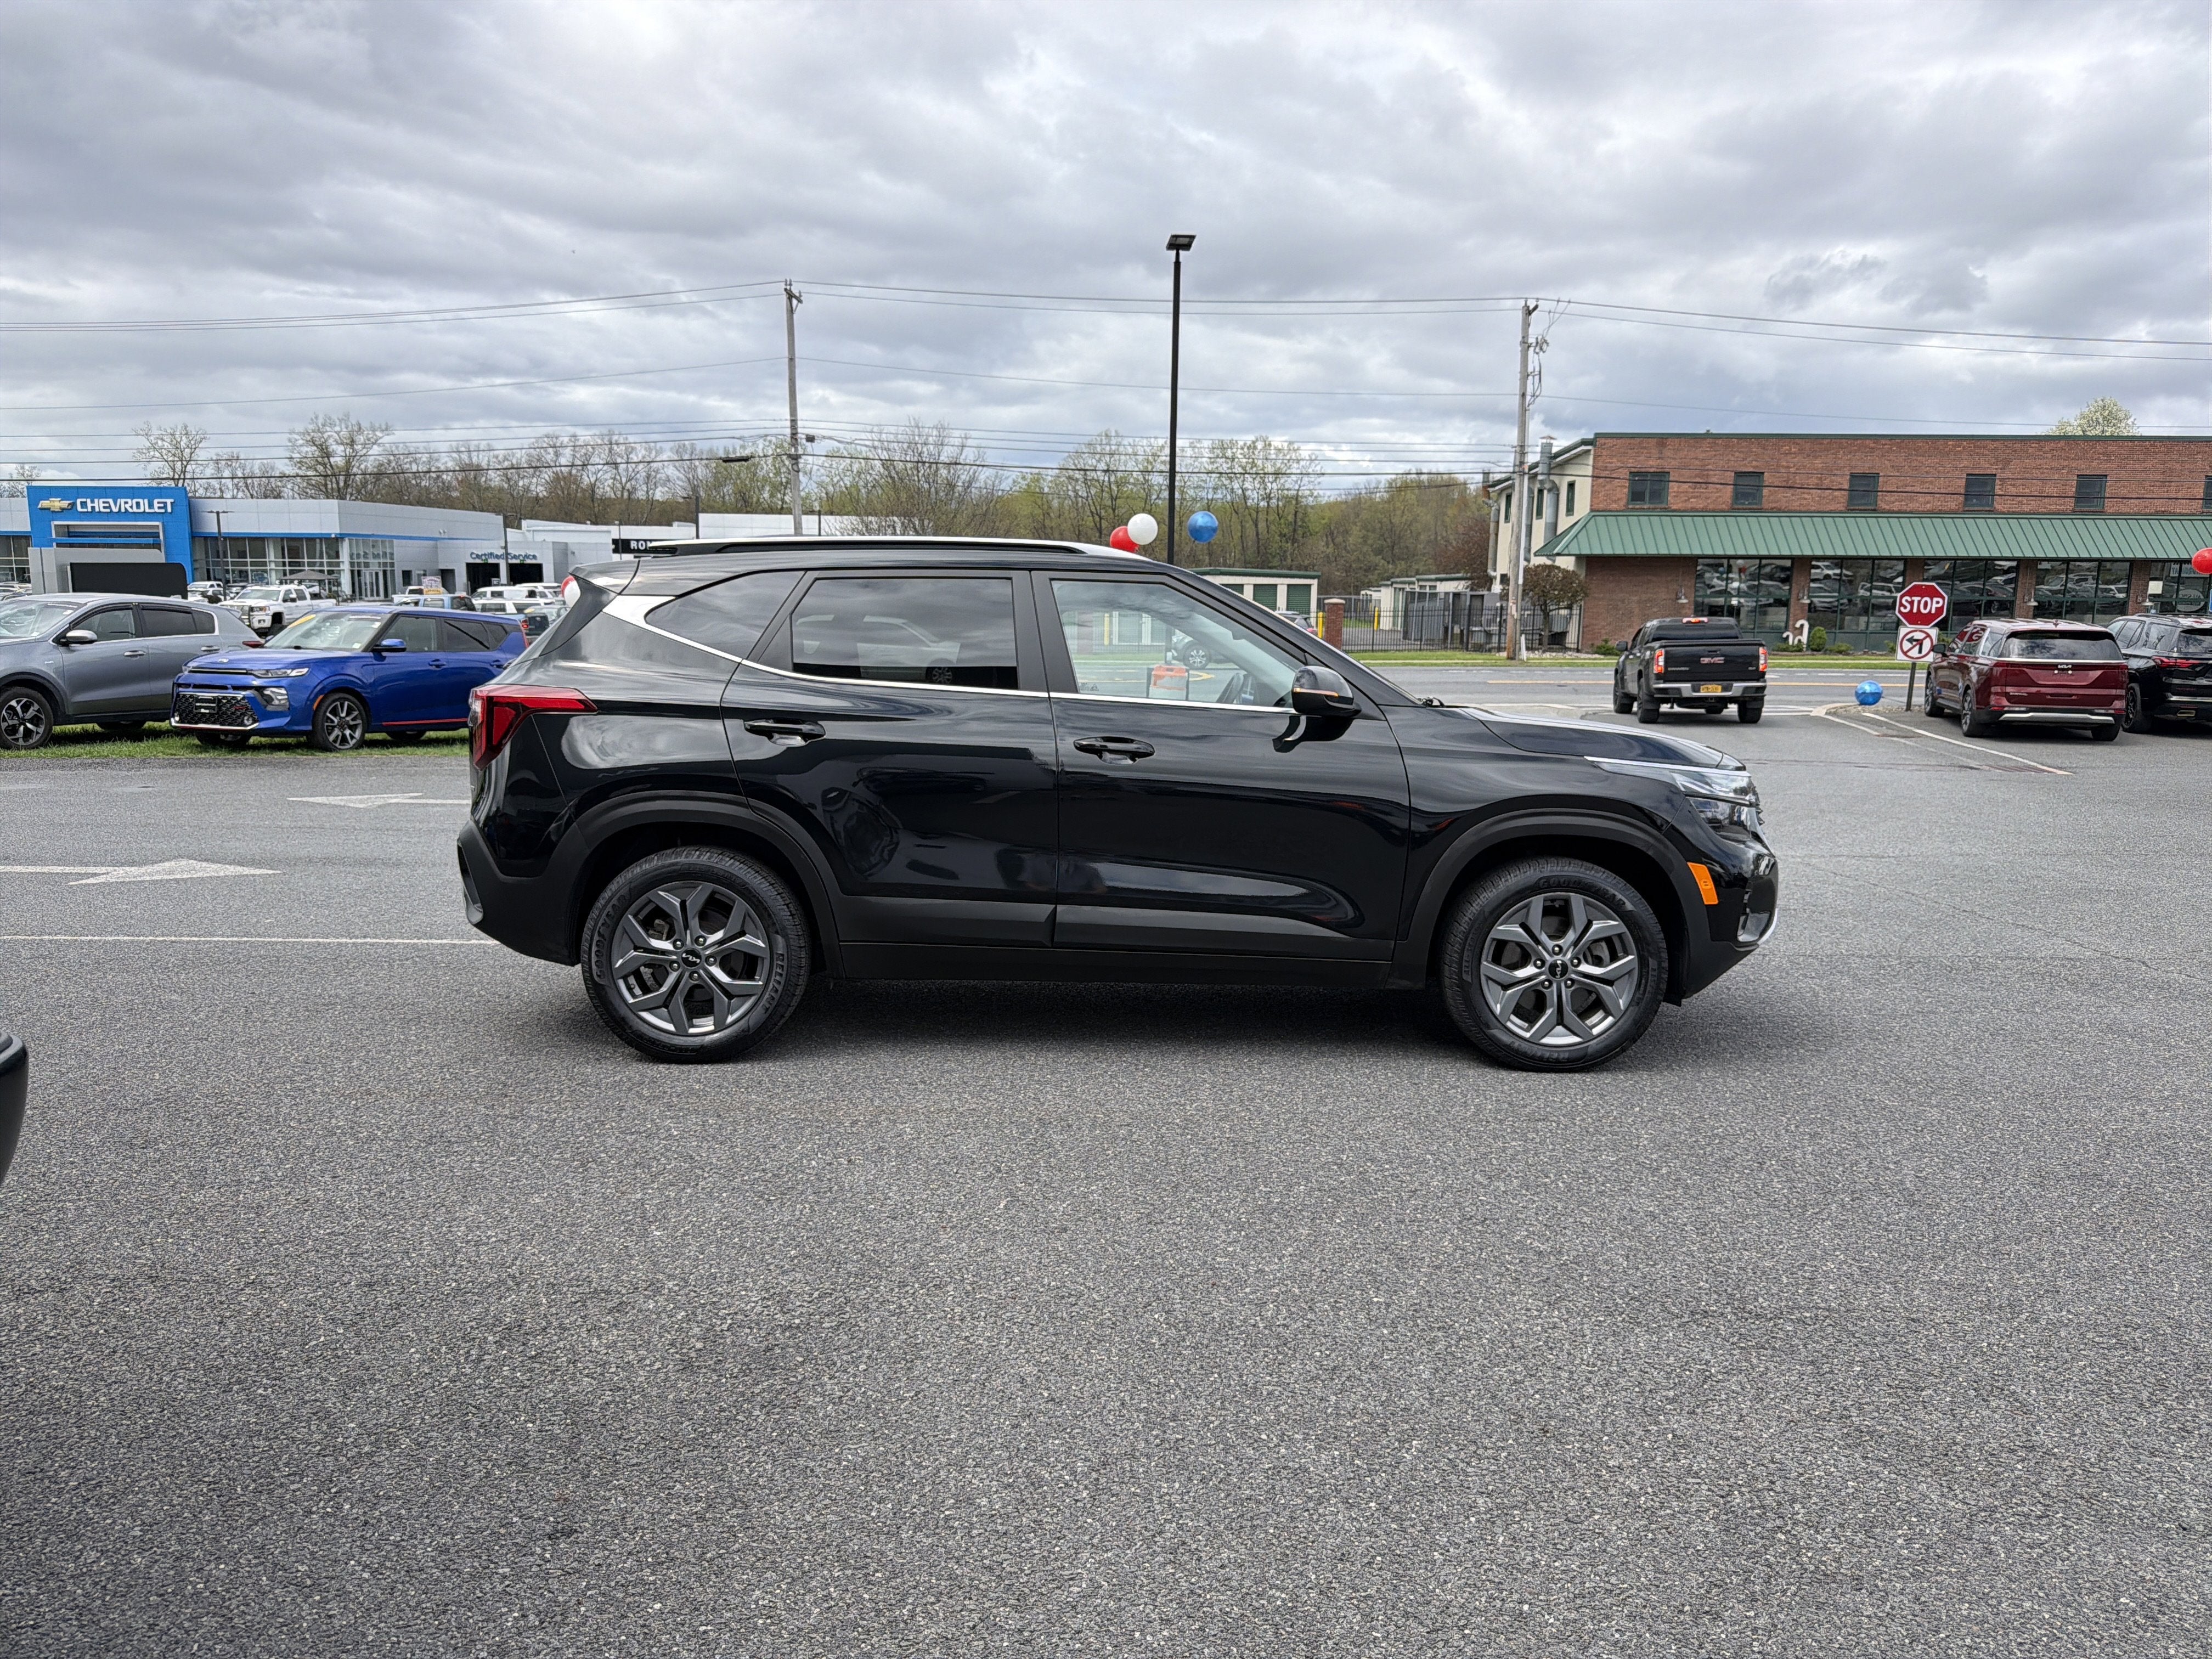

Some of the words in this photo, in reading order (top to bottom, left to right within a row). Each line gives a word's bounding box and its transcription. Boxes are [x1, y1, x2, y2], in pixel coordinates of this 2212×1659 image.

[76, 498, 174, 513] CHEVROLET
[470, 551, 505, 560] Certified
[507, 552, 537, 561] Service
[1900, 596, 1943, 614] STOP
[595, 894, 627, 980] GOODYEAR
[682, 953, 701, 964] KIA
[762, 952, 785, 1014] RELIANT
